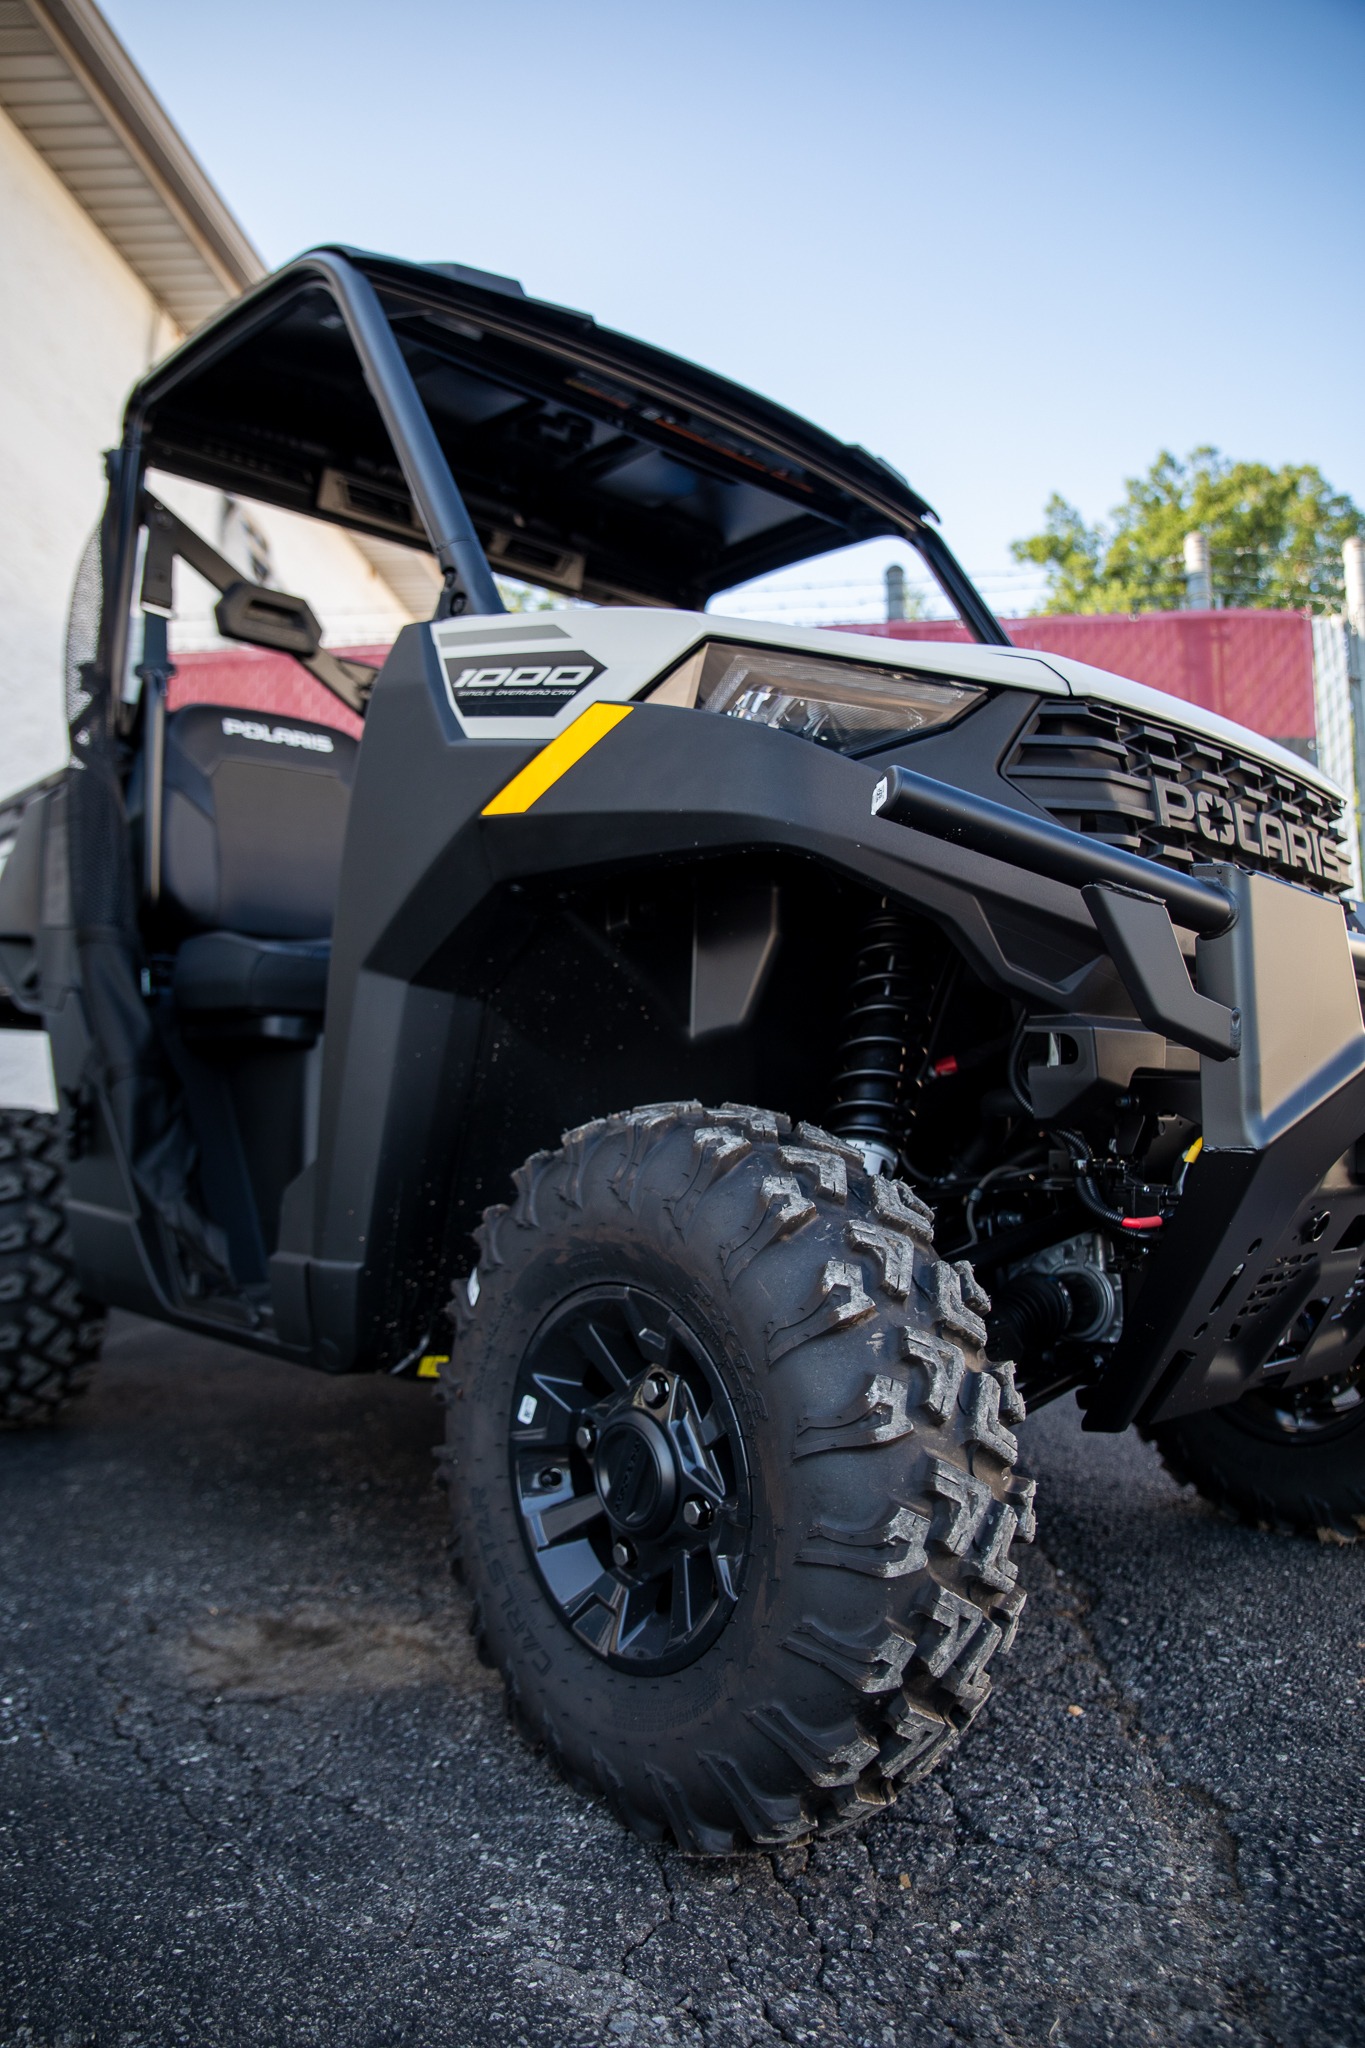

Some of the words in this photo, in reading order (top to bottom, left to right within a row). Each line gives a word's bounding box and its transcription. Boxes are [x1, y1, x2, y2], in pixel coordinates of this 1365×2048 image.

[453, 665, 594, 688] 1000
[222, 717, 334, 753] POLARIS
[1151, 776, 1342, 883] POLARIS
[470, 1486, 554, 1676] CARLSTAR
